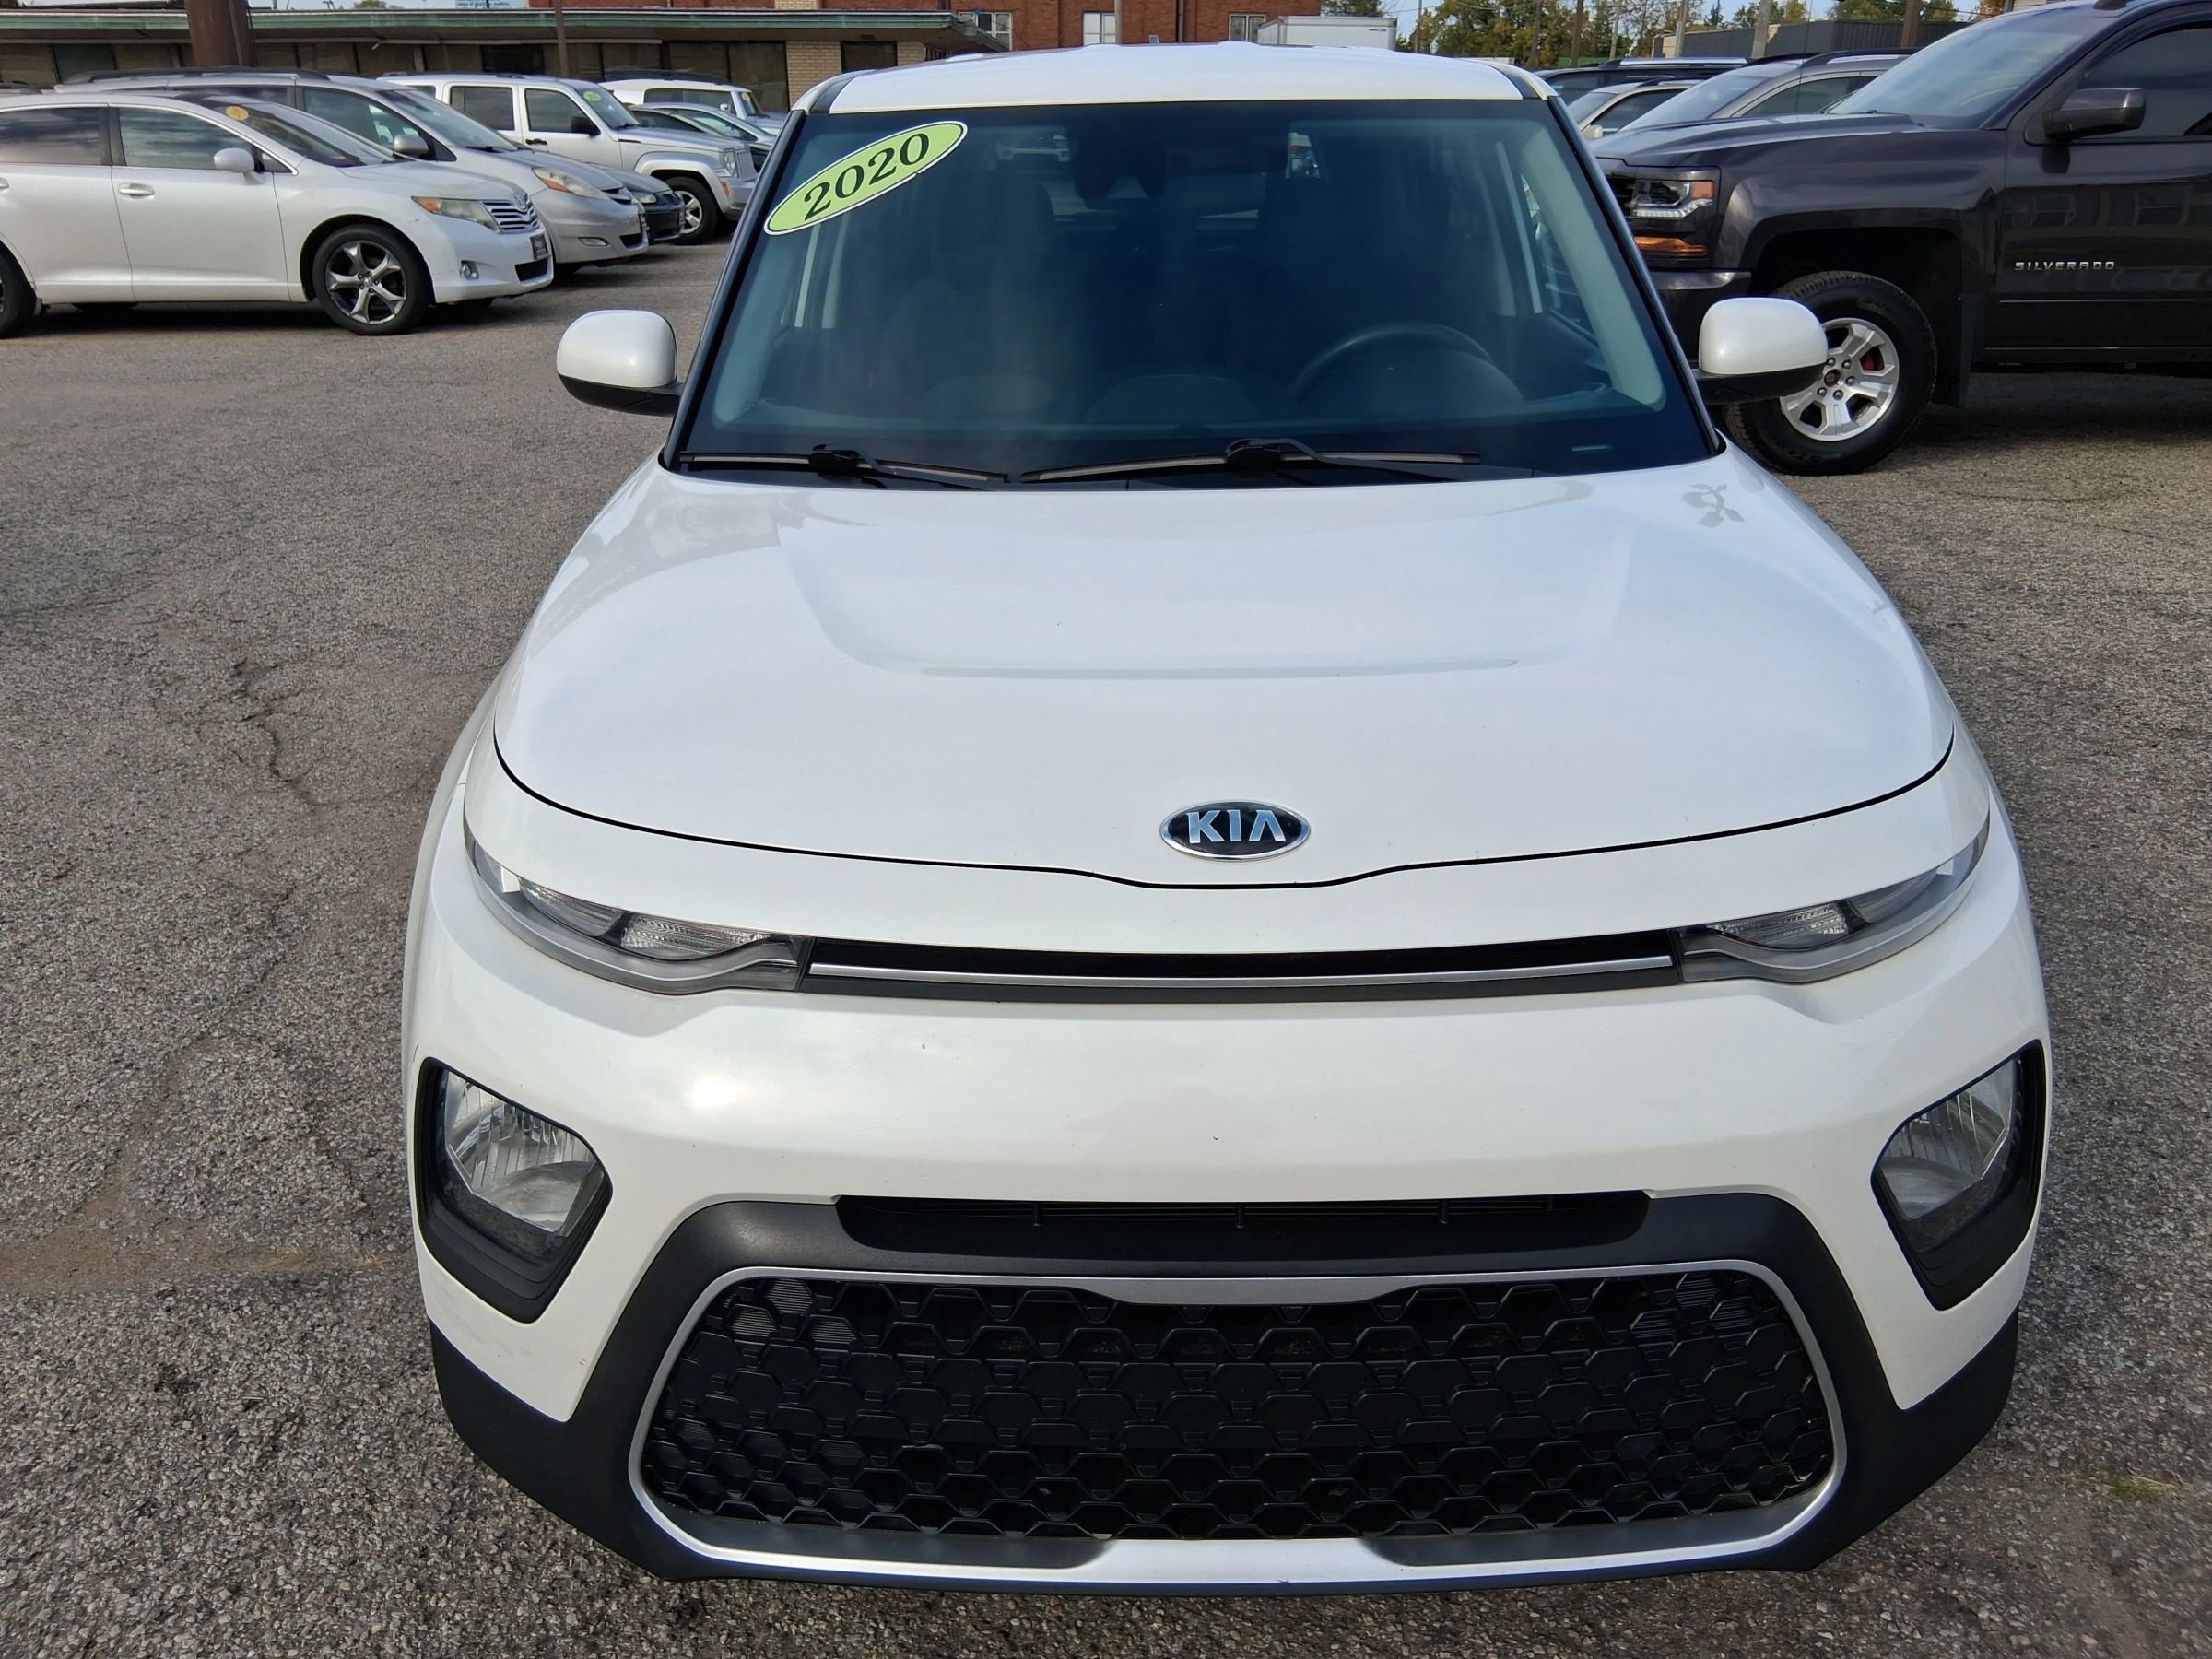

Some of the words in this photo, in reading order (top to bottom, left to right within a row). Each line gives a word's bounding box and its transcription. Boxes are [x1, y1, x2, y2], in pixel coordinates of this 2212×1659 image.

[804, 133, 930, 221] 2020
[2014, 261, 2115, 271] SILVERADO
[1185, 809, 1287, 844] KIA
